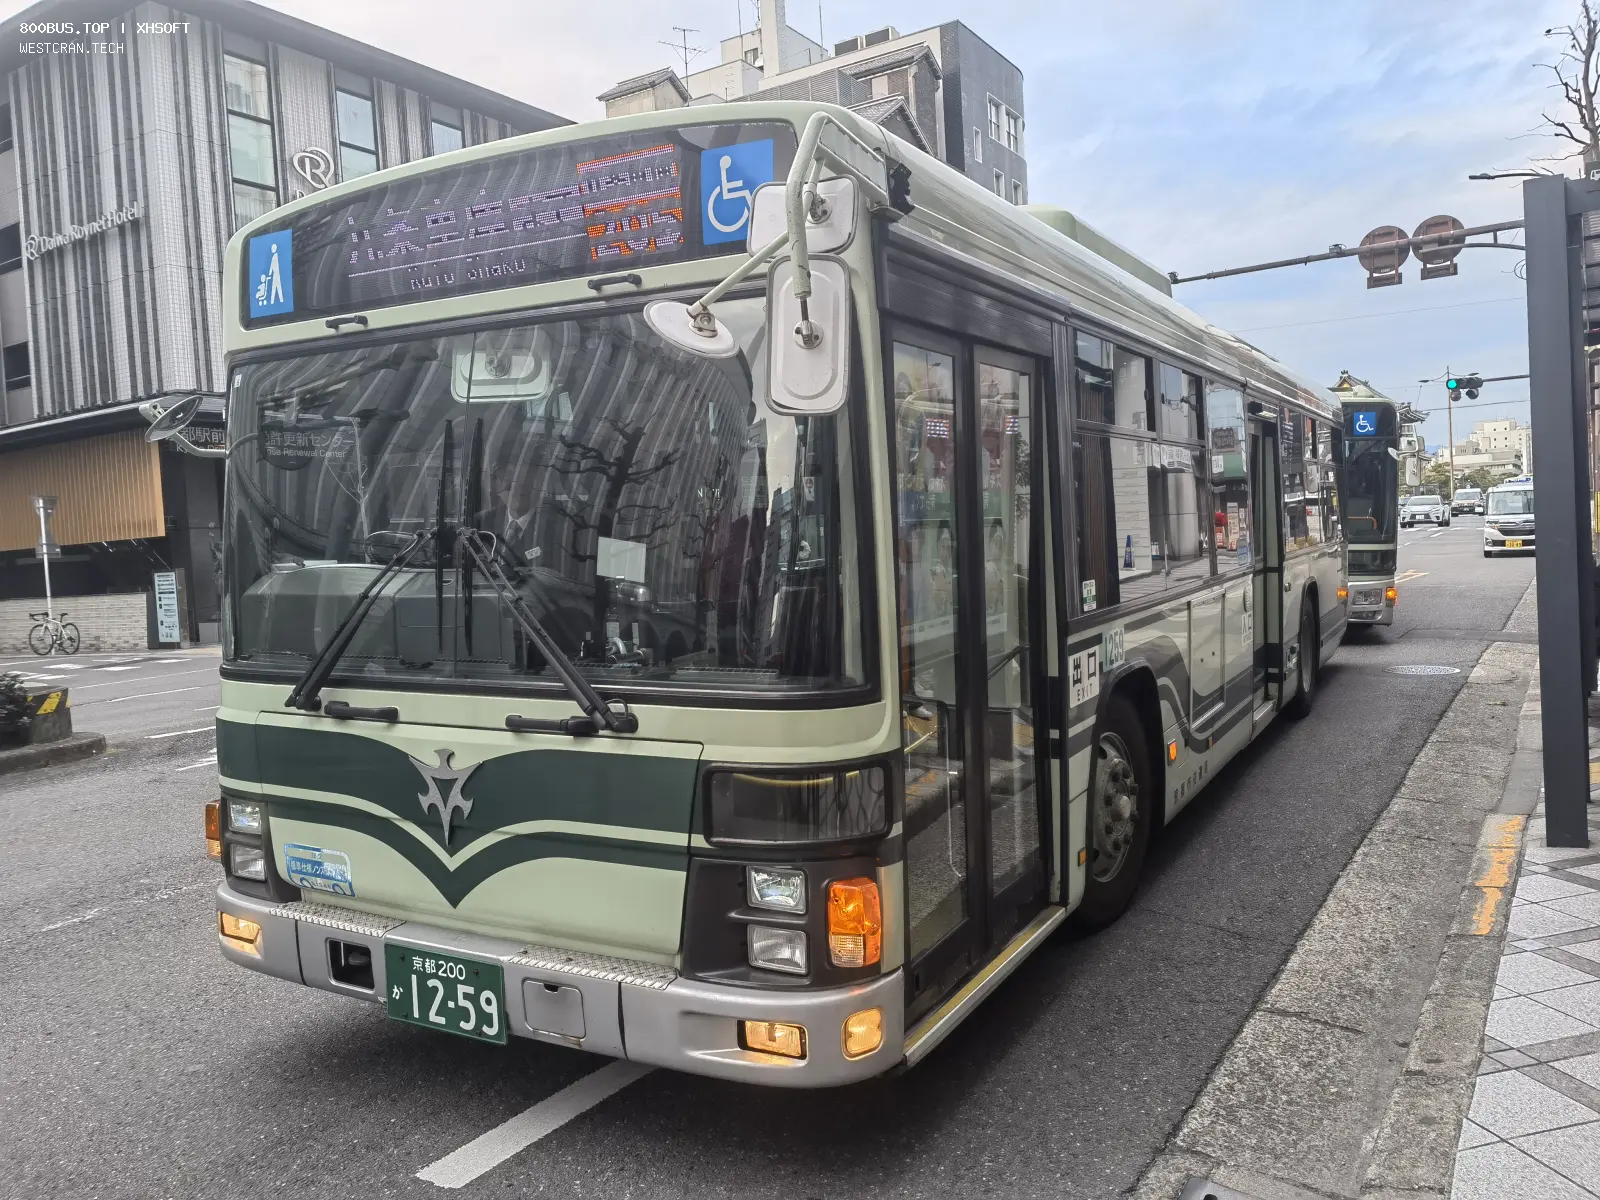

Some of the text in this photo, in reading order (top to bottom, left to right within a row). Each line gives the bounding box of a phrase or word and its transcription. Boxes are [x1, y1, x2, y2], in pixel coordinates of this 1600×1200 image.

[106, 200, 141, 229] Hotel
[180, 426, 226, 444] 都駅前
[283, 447, 318, 457] Renewal
[319, 450, 347, 458] Center
[1104, 629, 1125, 668] 1259
[1073, 649, 1097, 688] 出口
[1077, 683, 1093, 702] EXIT
[392, 973, 499, 1036] か 12-59
